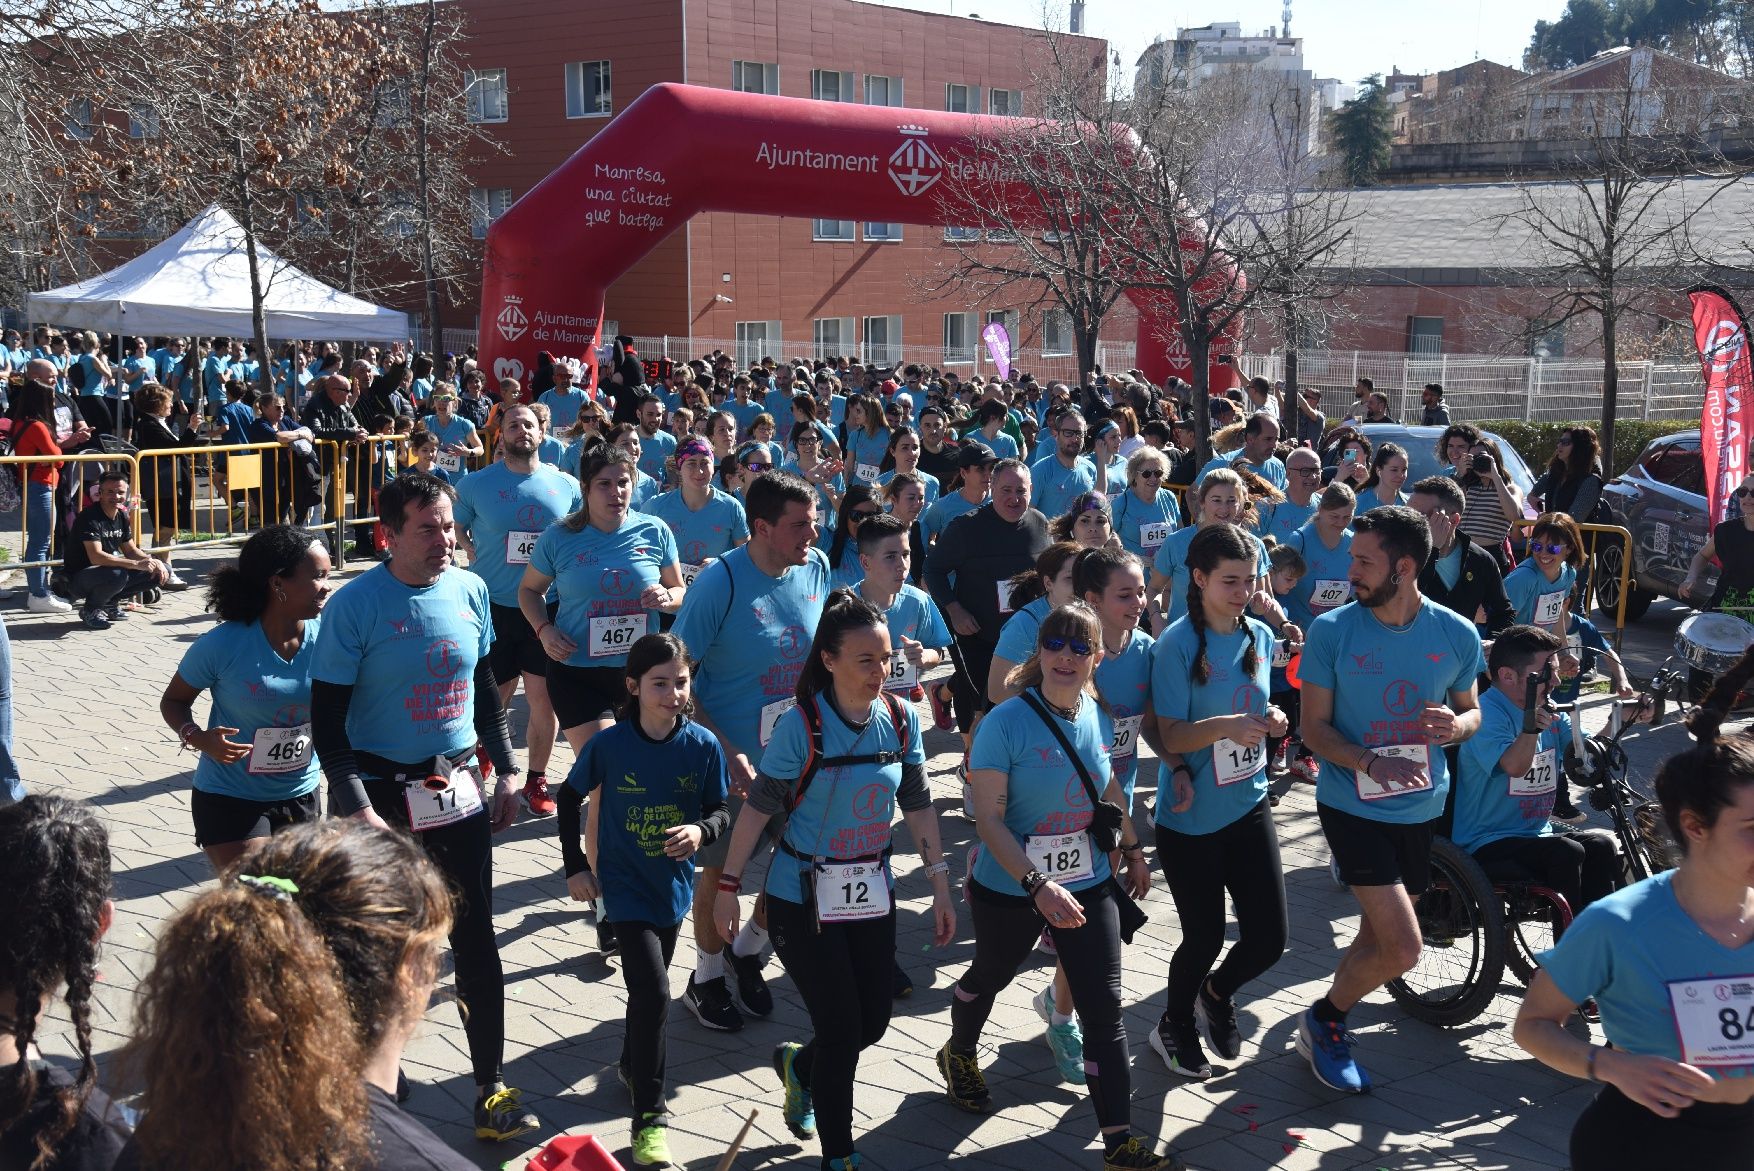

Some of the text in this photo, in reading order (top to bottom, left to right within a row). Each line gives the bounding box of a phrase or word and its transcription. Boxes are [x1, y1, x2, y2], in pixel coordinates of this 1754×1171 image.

[756, 142, 879, 173] Ajuntament
[950, 159, 976, 180] de
[595, 163, 666, 185] Manresa,
[585, 186, 672, 207] una ciutat
[585, 208, 664, 232] que batega
[532, 328, 596, 344] de Manresa
[439, 457, 456, 468] 544
[1147, 529, 1167, 541] 615
[1320, 589, 1343, 600] 407
[601, 627, 635, 645] 467
[267, 739, 305, 760] 469
[1229, 744, 1260, 768] 149
[1523, 765, 1551, 784] 472
[433, 787, 456, 811] 17
[644, 813, 655, 821] DE
[1043, 848, 1080, 872] 182
[841, 881, 869, 904] 12
